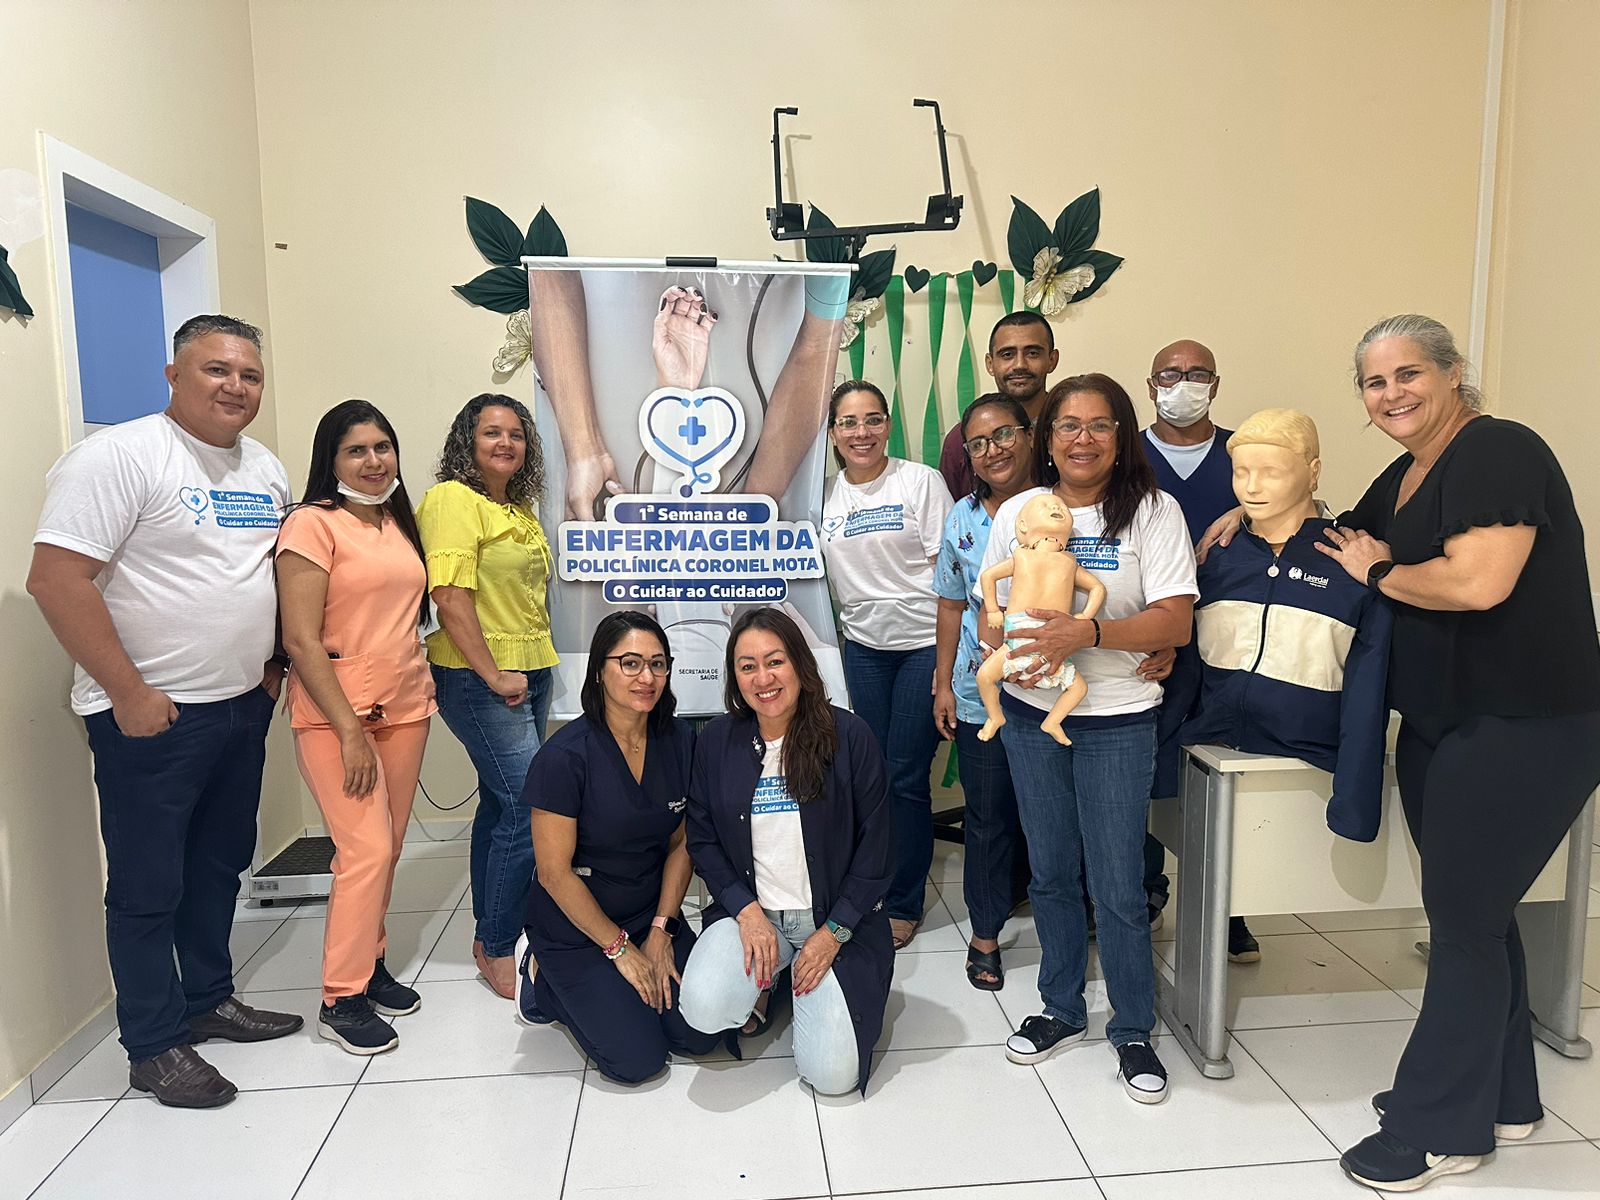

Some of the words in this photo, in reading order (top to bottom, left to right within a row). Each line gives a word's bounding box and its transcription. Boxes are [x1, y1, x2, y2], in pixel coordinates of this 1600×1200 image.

[225, 493, 256, 501] Semana
[212, 502, 265, 511] ENFERMAGEM
[639, 504, 655, 521] 1ª
[658, 508, 723, 521] Semana
[726, 508, 748, 521] de
[253, 519, 278, 527] Cuidador
[566, 529, 770, 552] ENFERMAGEM
[776, 528, 814, 551] DA
[566, 555, 682, 573] POLICLÍNICA
[685, 558, 769, 573] CORONEL
[772, 557, 819, 572] MOTA
[613, 585, 626, 598] O
[629, 585, 683, 599] Cuidar
[686, 587, 706, 598] ao
[710, 584, 784, 598] Cuidador
[760, 804, 782, 812] Cuidar
